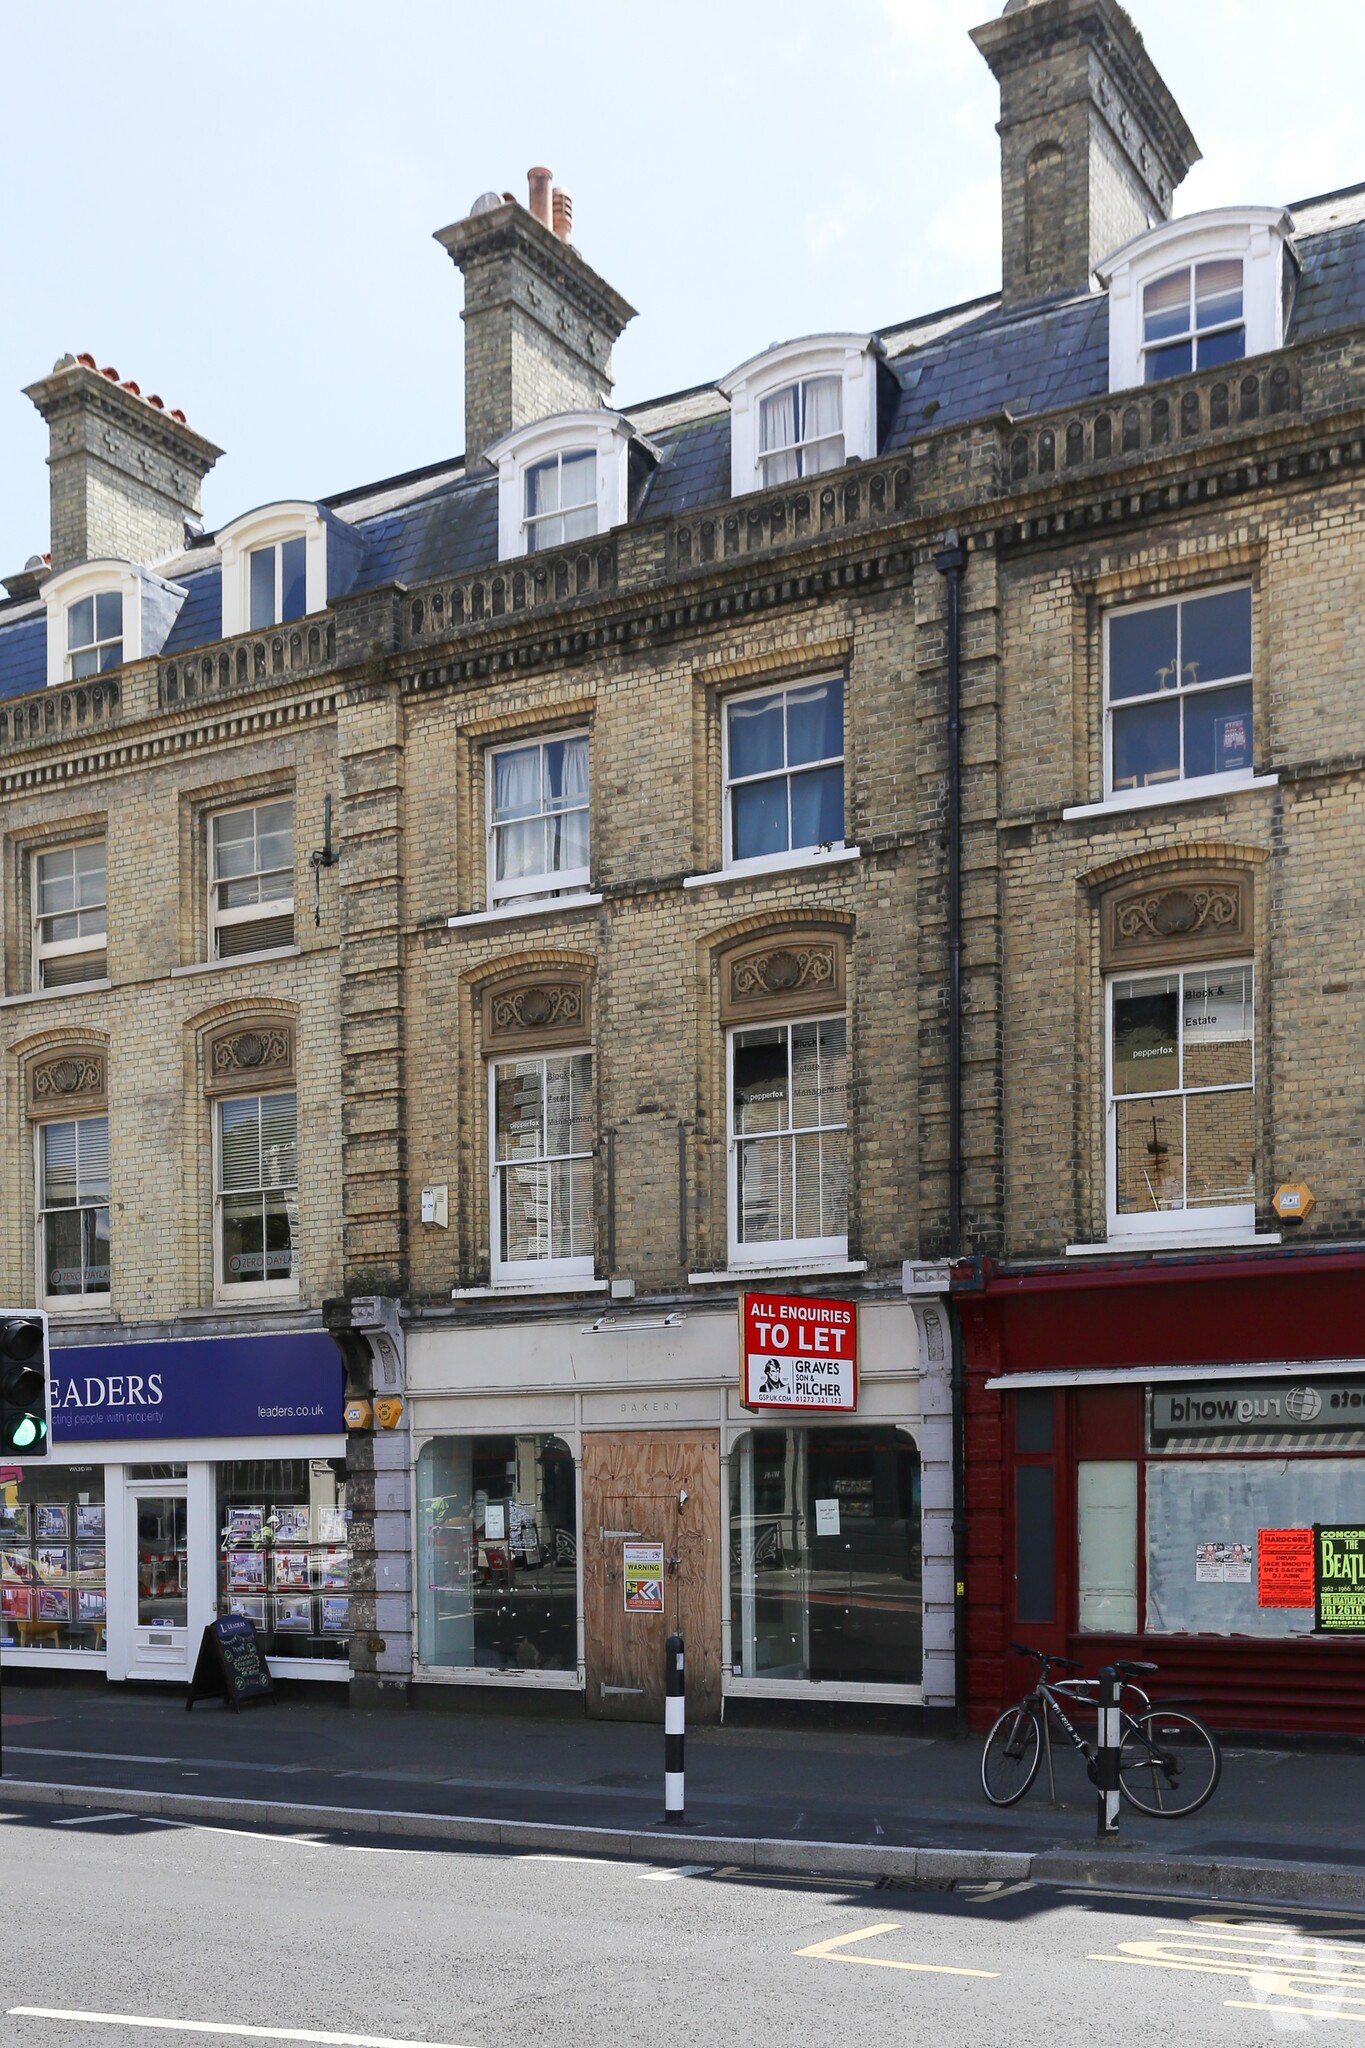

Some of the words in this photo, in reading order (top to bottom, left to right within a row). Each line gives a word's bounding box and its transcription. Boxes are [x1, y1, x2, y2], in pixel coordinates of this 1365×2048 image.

[1185, 988, 1213, 999] Block
[1217, 986, 1224, 996] &
[1185, 1016, 1217, 1026] Estate
[1133, 1047, 1173, 1058] pepperfox
[794, 1063, 820, 1073] Estate
[750, 1090, 784, 1101] pepperfox
[510, 1120, 540, 1130] pepperfox
[1281, 1195, 1300, 1205] ADT
[750, 1303, 776, 1318] ALL
[780, 1306, 851, 1324] ENQUIRIES
[755, 1322, 790, 1349] TO
[798, 1325, 846, 1353] LET
[795, 1360, 840, 1375] GRAVES
[796, 1374, 809, 1382] SON
[796, 1383, 841, 1396] PILCHER
[257, 1404, 324, 1418] leaders.co.uk
[620, 1402, 679, 1412] BAKERY
[74, 1412, 104, 1426] people
[106, 1411, 125, 1423] with
[126, 1410, 164, 1425] property
[349, 1410, 360, 1419] ADT
[1345, 1539, 1359, 1550] THE
[1321, 1606, 1336, 1615] FRI
[1337, 1606, 1363, 1615] 26TH
[227, 1622, 246, 1630] LEADERS
